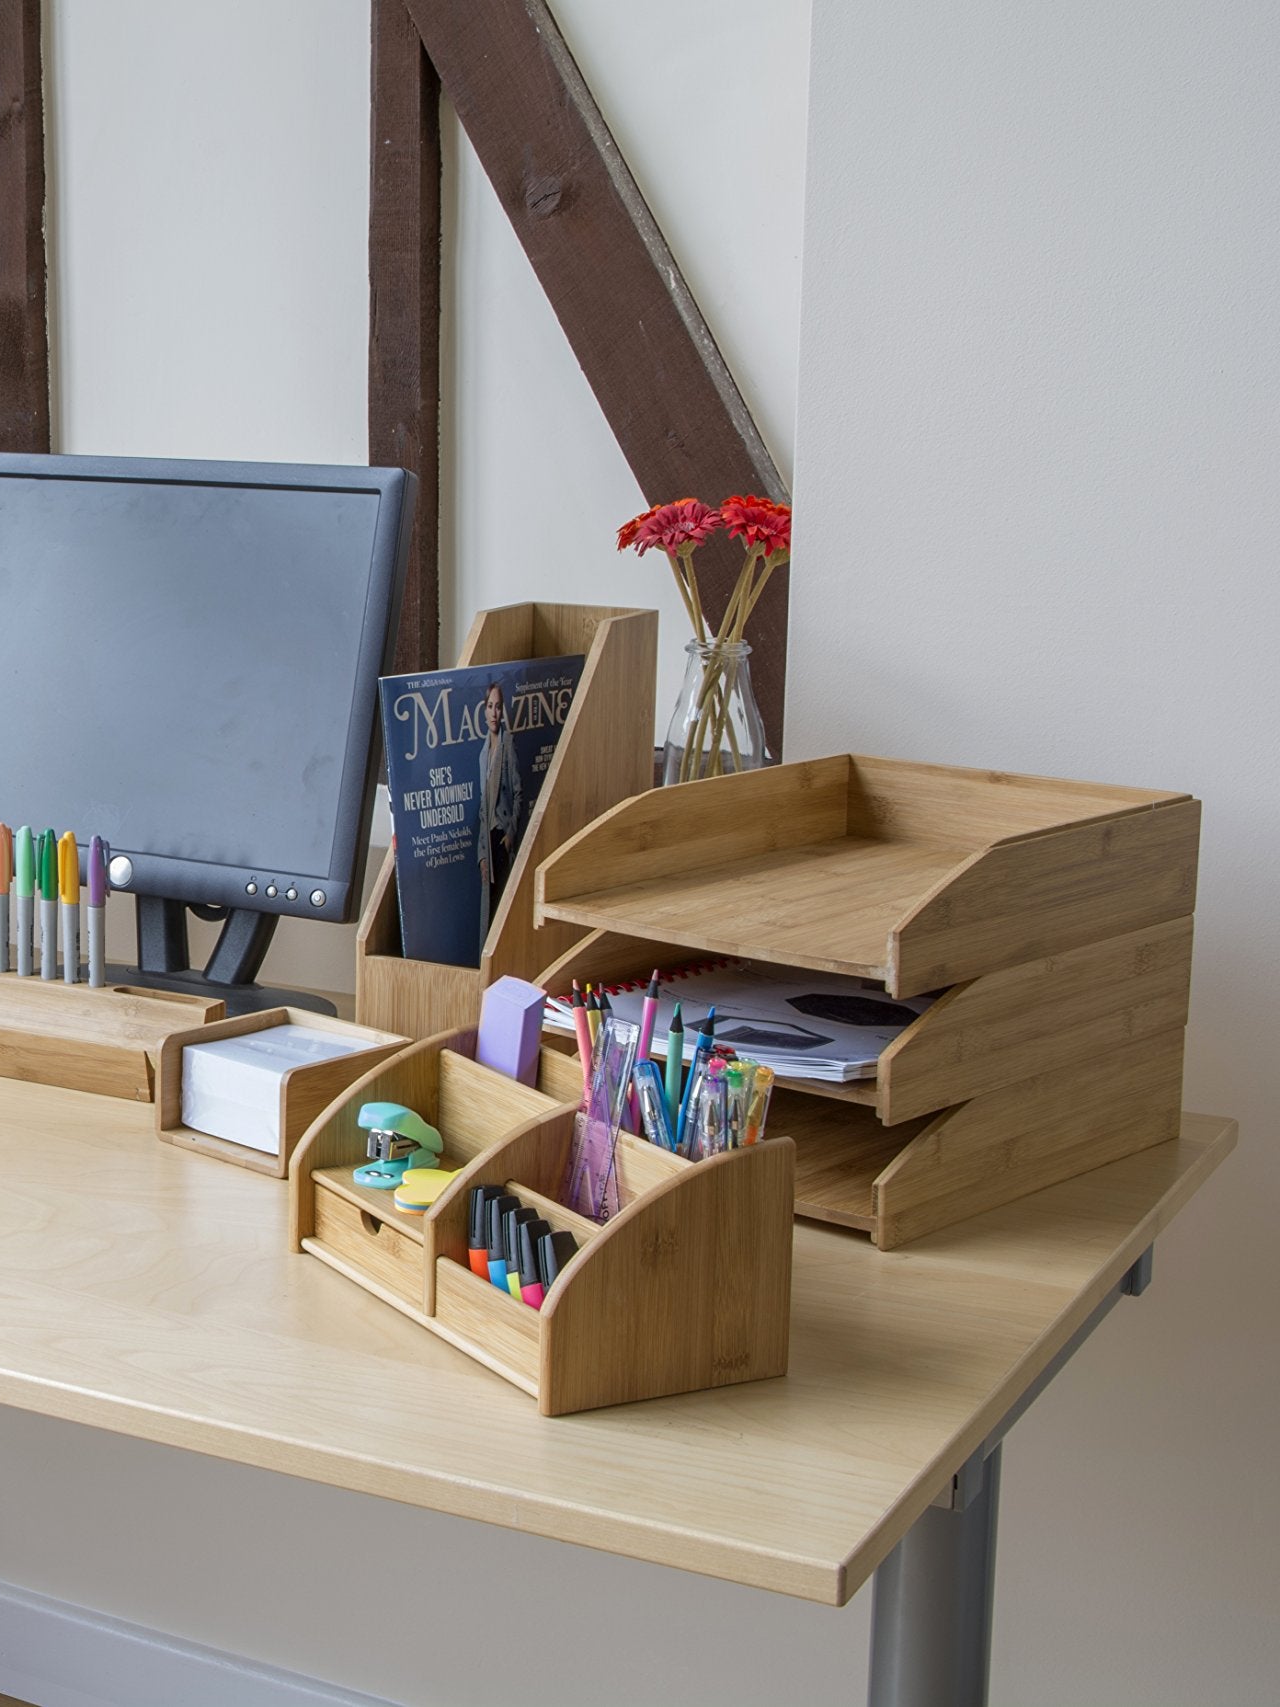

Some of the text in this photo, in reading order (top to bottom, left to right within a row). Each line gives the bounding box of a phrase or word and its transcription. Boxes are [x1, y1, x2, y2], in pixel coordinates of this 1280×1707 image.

[406, 681, 420, 689] THE
[550, 677, 559, 687] the
[429, 766, 453, 787] SHE'S
[403, 781, 473, 811] NEVER KNOWINGLY
[420, 803, 465, 829] UNDERSOLD
[411, 835, 430, 846] Meet
[430, 831, 448, 843] Paula
[413, 847, 426, 858] the
[426, 845, 441, 856] first
[425, 856, 434, 868] of
[433, 855, 448, 868] John
